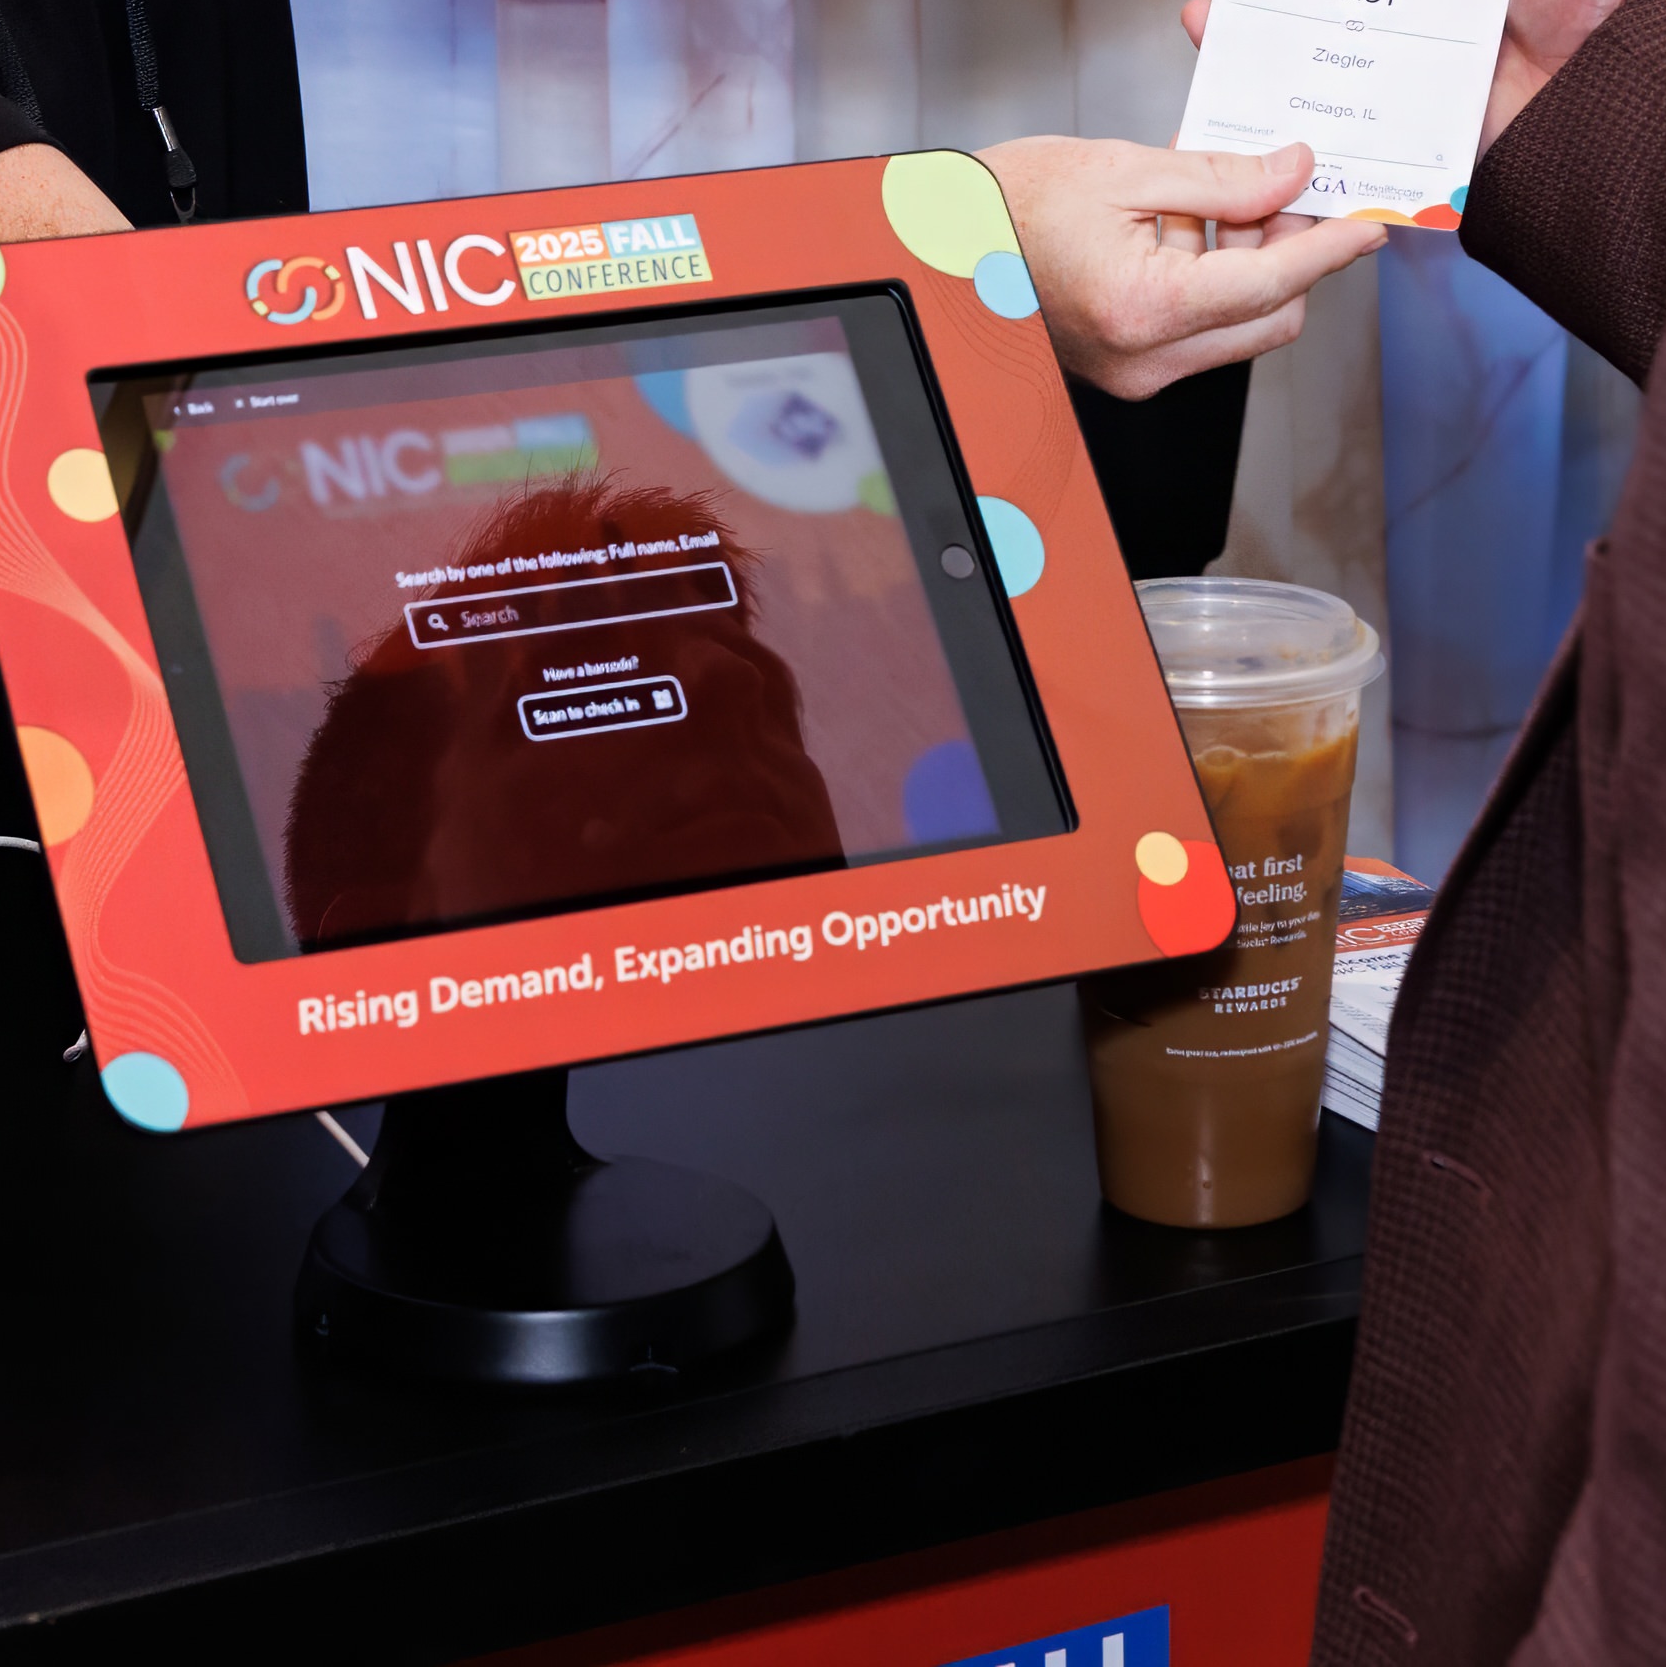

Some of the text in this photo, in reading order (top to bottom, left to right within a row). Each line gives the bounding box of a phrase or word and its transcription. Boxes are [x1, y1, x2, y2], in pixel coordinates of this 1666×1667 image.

[1313, 48, 1375, 70] Ziegler
[1362, 108, 1377, 121] IL
[345, 219, 698, 320] NIC 2025 FALL
[529, 254, 703, 296] CONFERENCE
[298, 429, 441, 505] NIC
[395, 567, 447, 589] Search
[446, 565, 466, 583] by
[466, 563, 495, 579] one
[495, 557, 512, 575] of
[512, 556, 539, 573] the
[608, 541, 637, 561] Full
[678, 530, 720, 551] Email
[460, 605, 520, 629] Search
[533, 695, 641, 726] Scan to check in
[1263, 853, 1303, 877] first
[1236, 881, 1307, 906] feeling.
[298, 882, 1048, 1035] Rising Demand, Expanding Opportunity
[1214, 996, 1287, 1014] REWARDS
